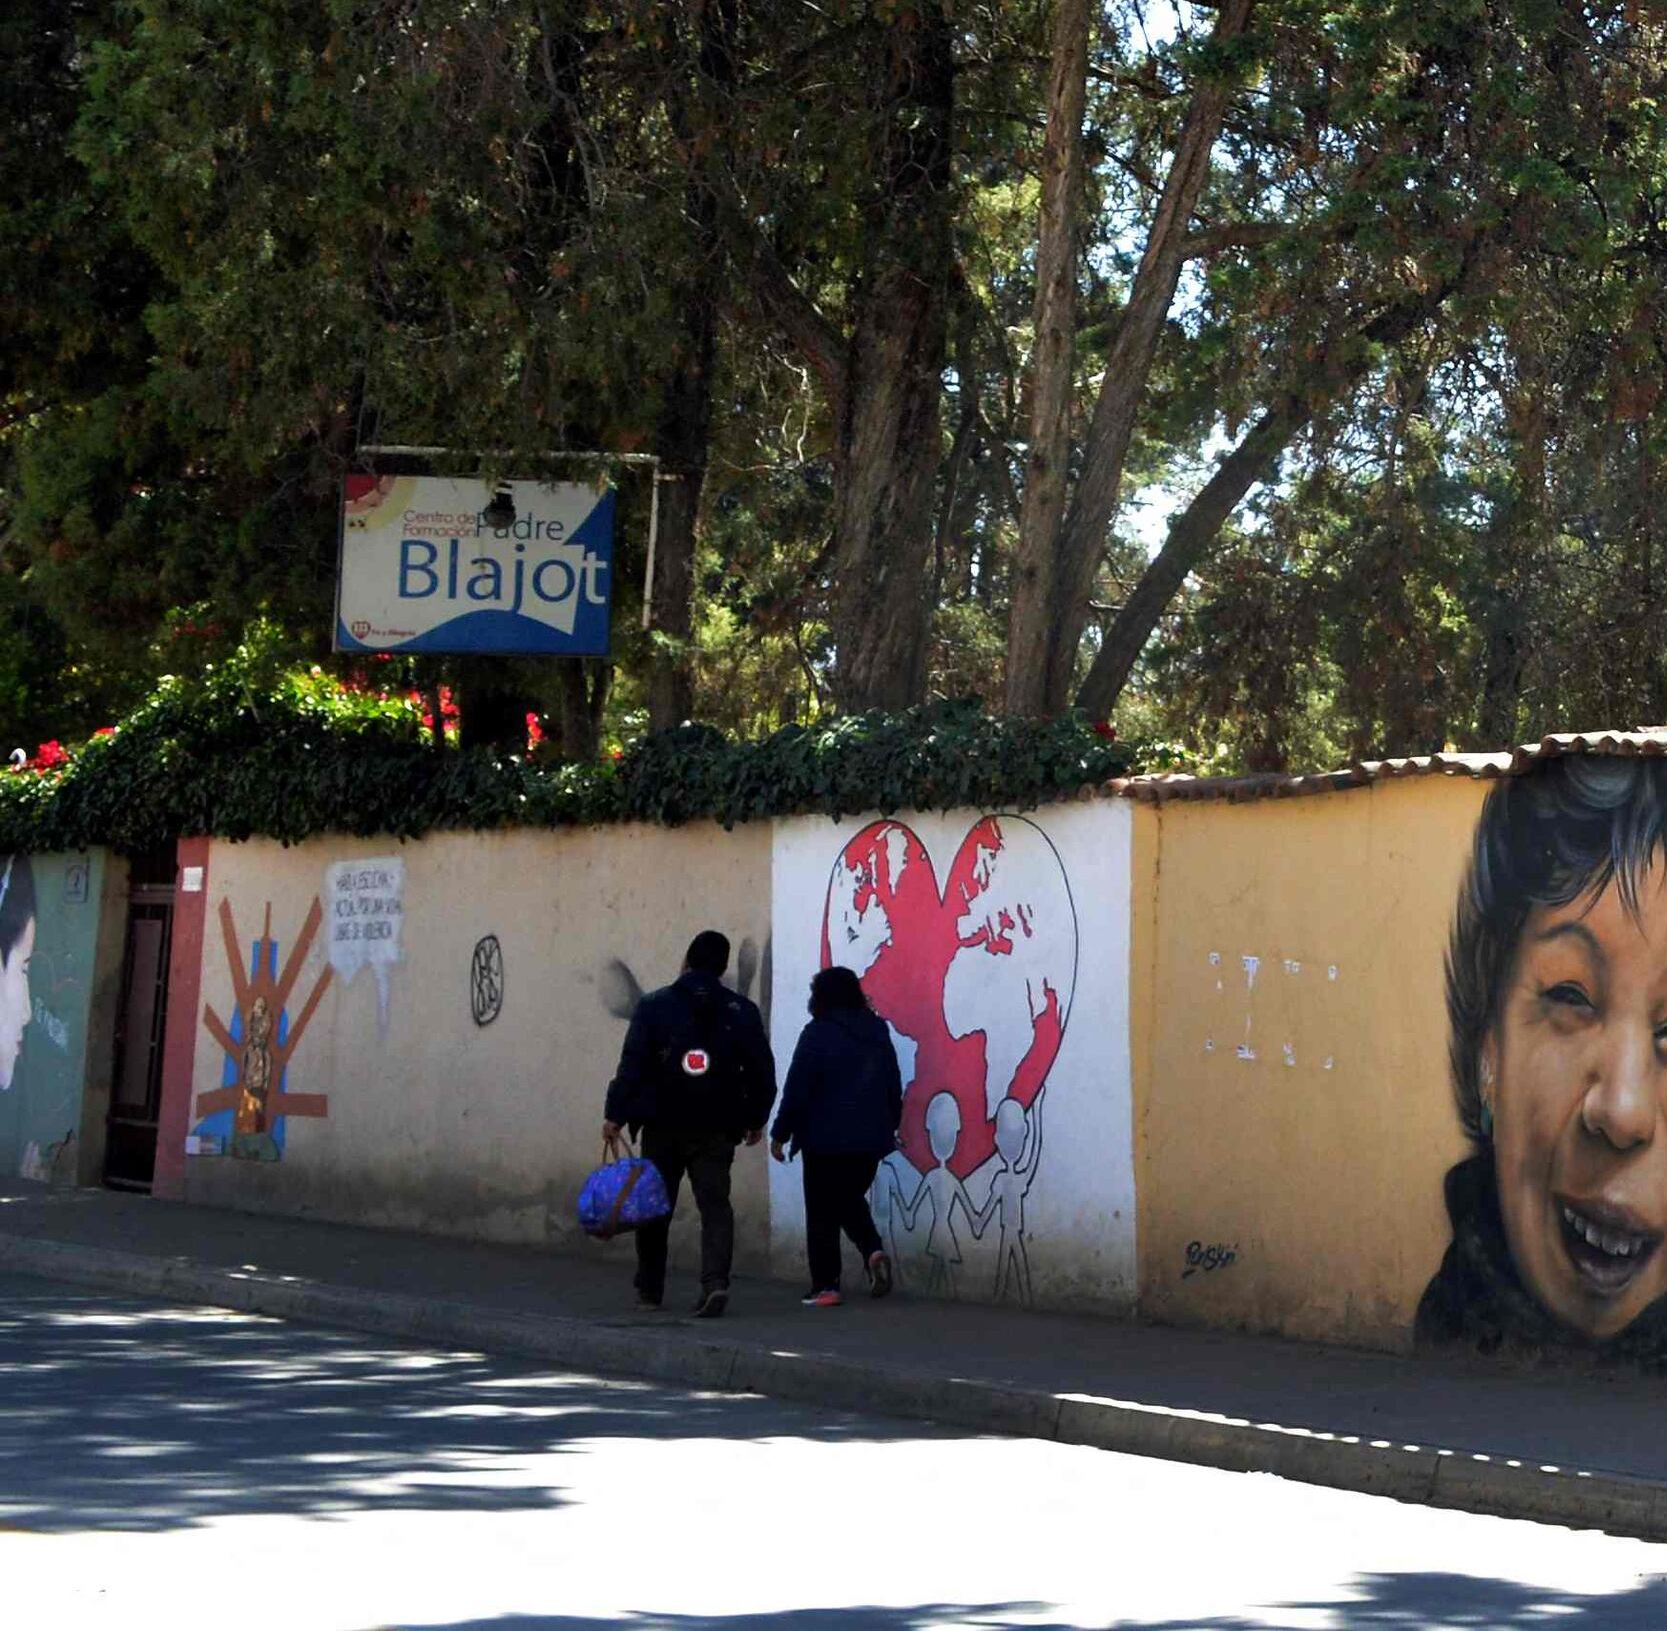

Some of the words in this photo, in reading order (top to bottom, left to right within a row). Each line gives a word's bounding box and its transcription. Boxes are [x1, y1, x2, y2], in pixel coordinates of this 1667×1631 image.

[404, 510, 453, 523] Centro
[457, 510, 476, 524] de
[398, 538, 607, 614] Blajot
